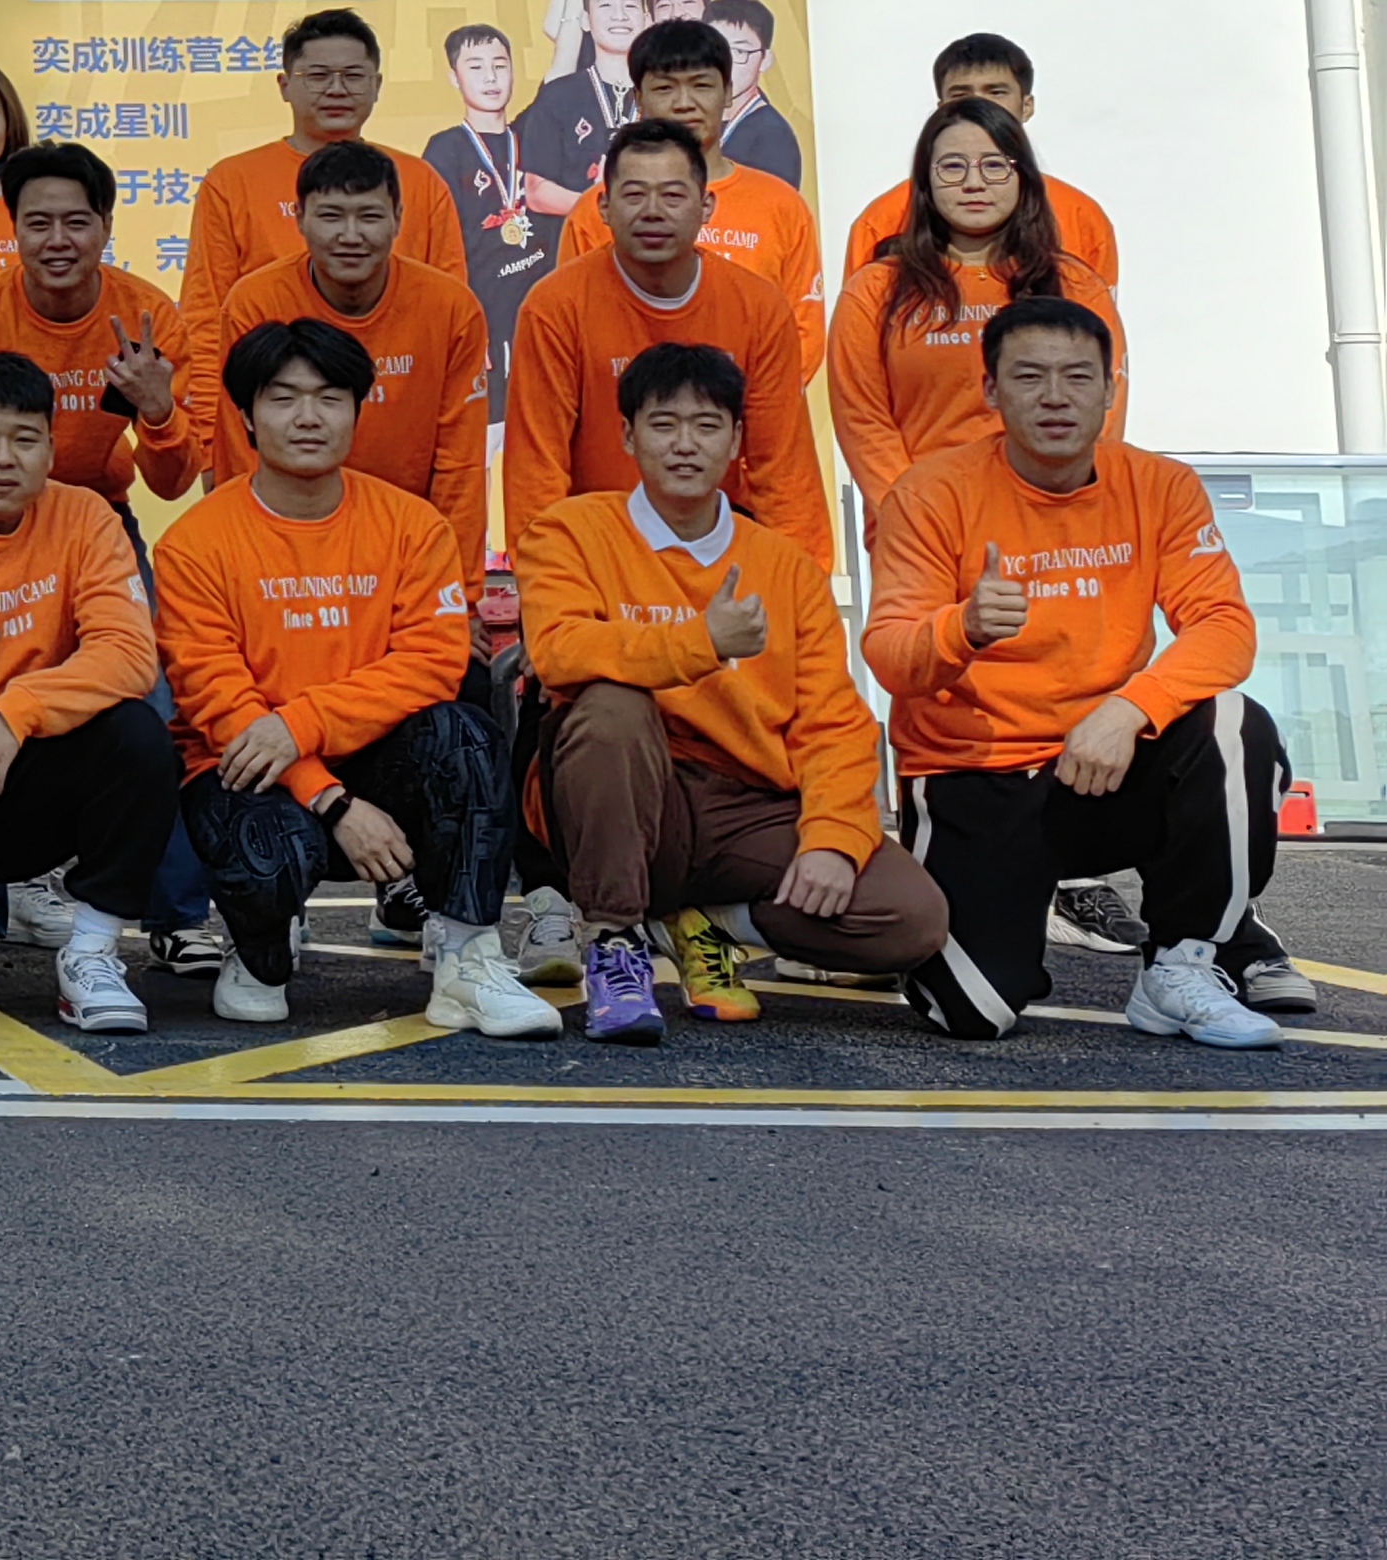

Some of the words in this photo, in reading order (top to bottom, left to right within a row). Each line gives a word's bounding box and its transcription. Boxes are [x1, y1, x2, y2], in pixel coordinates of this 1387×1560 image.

[35, 102, 189, 139] 奕成星训
[724, 228, 759, 249] CAMP
[925, 332, 972, 346] Since
[375, 354, 414, 376] CAMP
[60, 393, 97, 413] 2013
[1003, 555, 1027, 576] YC
[19, 573, 58, 605] CAMP
[259, 577, 278, 601] YC
[318, 606, 349, 628] 201
